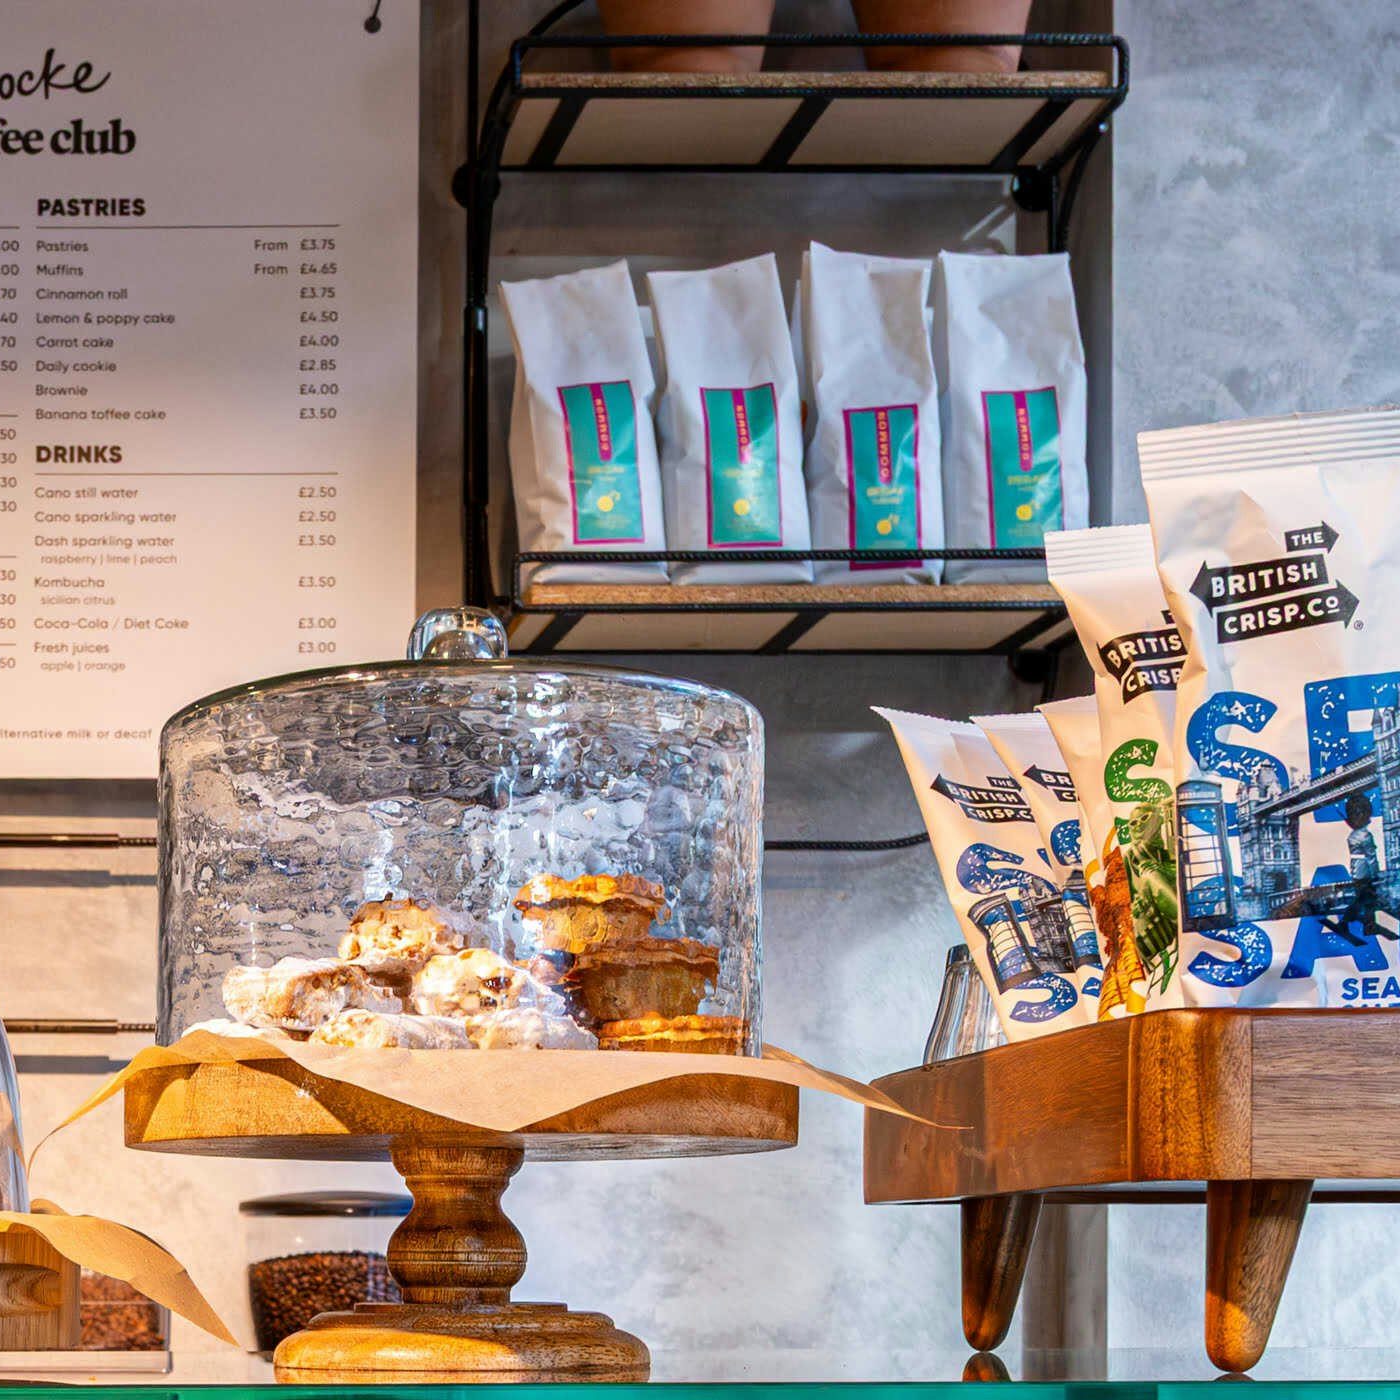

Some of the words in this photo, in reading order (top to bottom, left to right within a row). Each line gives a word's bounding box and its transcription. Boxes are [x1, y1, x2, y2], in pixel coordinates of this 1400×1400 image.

[50, 118, 137, 155] club
[38, 198, 145, 216] PASTRIES
[36, 240, 88, 252] Pastries
[255, 240, 288, 251] From
[301, 239, 335, 250] £3.75
[37, 264, 83, 276] Muffins
[254, 264, 288, 275] From
[300, 263, 337, 274] £4.65
[36, 288, 104, 300] Cinnamon
[108, 288, 127, 300] roll
[300, 287, 335, 299] £3.75
[36, 313, 79, 324] Lemon
[84, 312, 92, 323] &
[97, 315, 140, 325] poppy
[143, 314, 175, 324] cake
[300, 311, 338, 322] £4.50
[36, 336, 78, 348] Carrot
[82, 337, 113, 347] cake
[300, 335, 339, 347] £4.00
[36, 360, 69, 374] Daily
[73, 361, 116, 372] cookie
[300, 359, 336, 371] £2.85
[36, 384, 88, 396] Brownie
[300, 384, 339, 395] £4.00
[36, 408, 87, 420] Banana
[91, 409, 130, 420] toffee
[134, 410, 166, 420] cake
[300, 408, 336, 419] £3.50
[36, 446, 122, 463] DRINKS
[75, 488, 96, 498] still
[101, 489, 138, 498] water
[298, 487, 336, 498] £2.50
[75, 512, 135, 525] sparkling
[140, 513, 176, 522] water
[299, 511, 336, 522] £2.50
[72, 536, 133, 549] sparkling
[137, 537, 174, 546] water
[299, 535, 336, 546] £3.50
[1291, 531, 1325, 547] THE
[34, 577, 105, 587] Kombucha
[299, 576, 336, 587] £3.50
[1211, 561, 1319, 598] BRITISH
[34, 618, 108, 629] Coca-Cola
[124, 618, 150, 629] Diet
[155, 618, 189, 629] Coke
[298, 618, 336, 629] £3.00
[34, 642, 68, 653] Fresh
[72, 644, 109, 655] juices
[298, 642, 336, 653] £3.00
[1107, 634, 1182, 668] BRITIS
[1126, 668, 1181, 692] CRISP
[992, 778, 1013, 788] THE
[946, 782, 1018, 803] BRITISH
[967, 808, 1032, 820] CRISP.C
